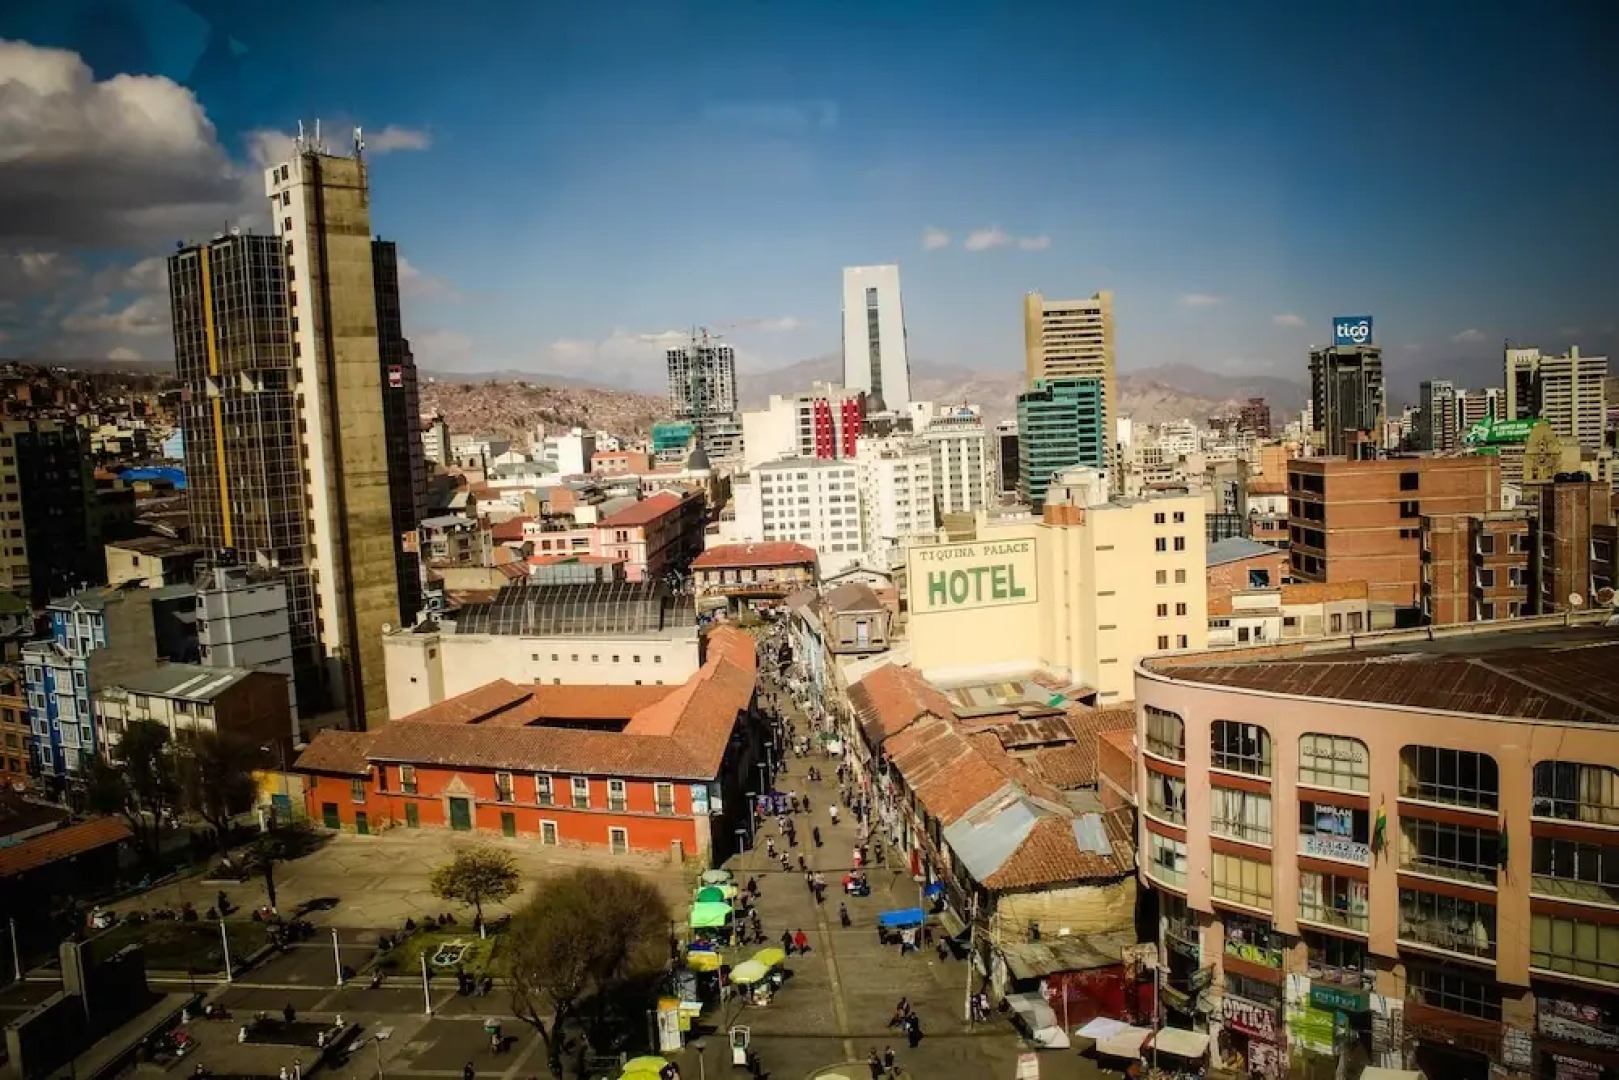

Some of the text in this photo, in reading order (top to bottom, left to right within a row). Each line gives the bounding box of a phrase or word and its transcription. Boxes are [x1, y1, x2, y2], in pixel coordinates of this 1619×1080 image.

[920, 543, 1029, 561] TIQUINA PALACE
[927, 564, 1026, 606] HOTEL
[1223, 998, 1274, 1033] OPTICA
